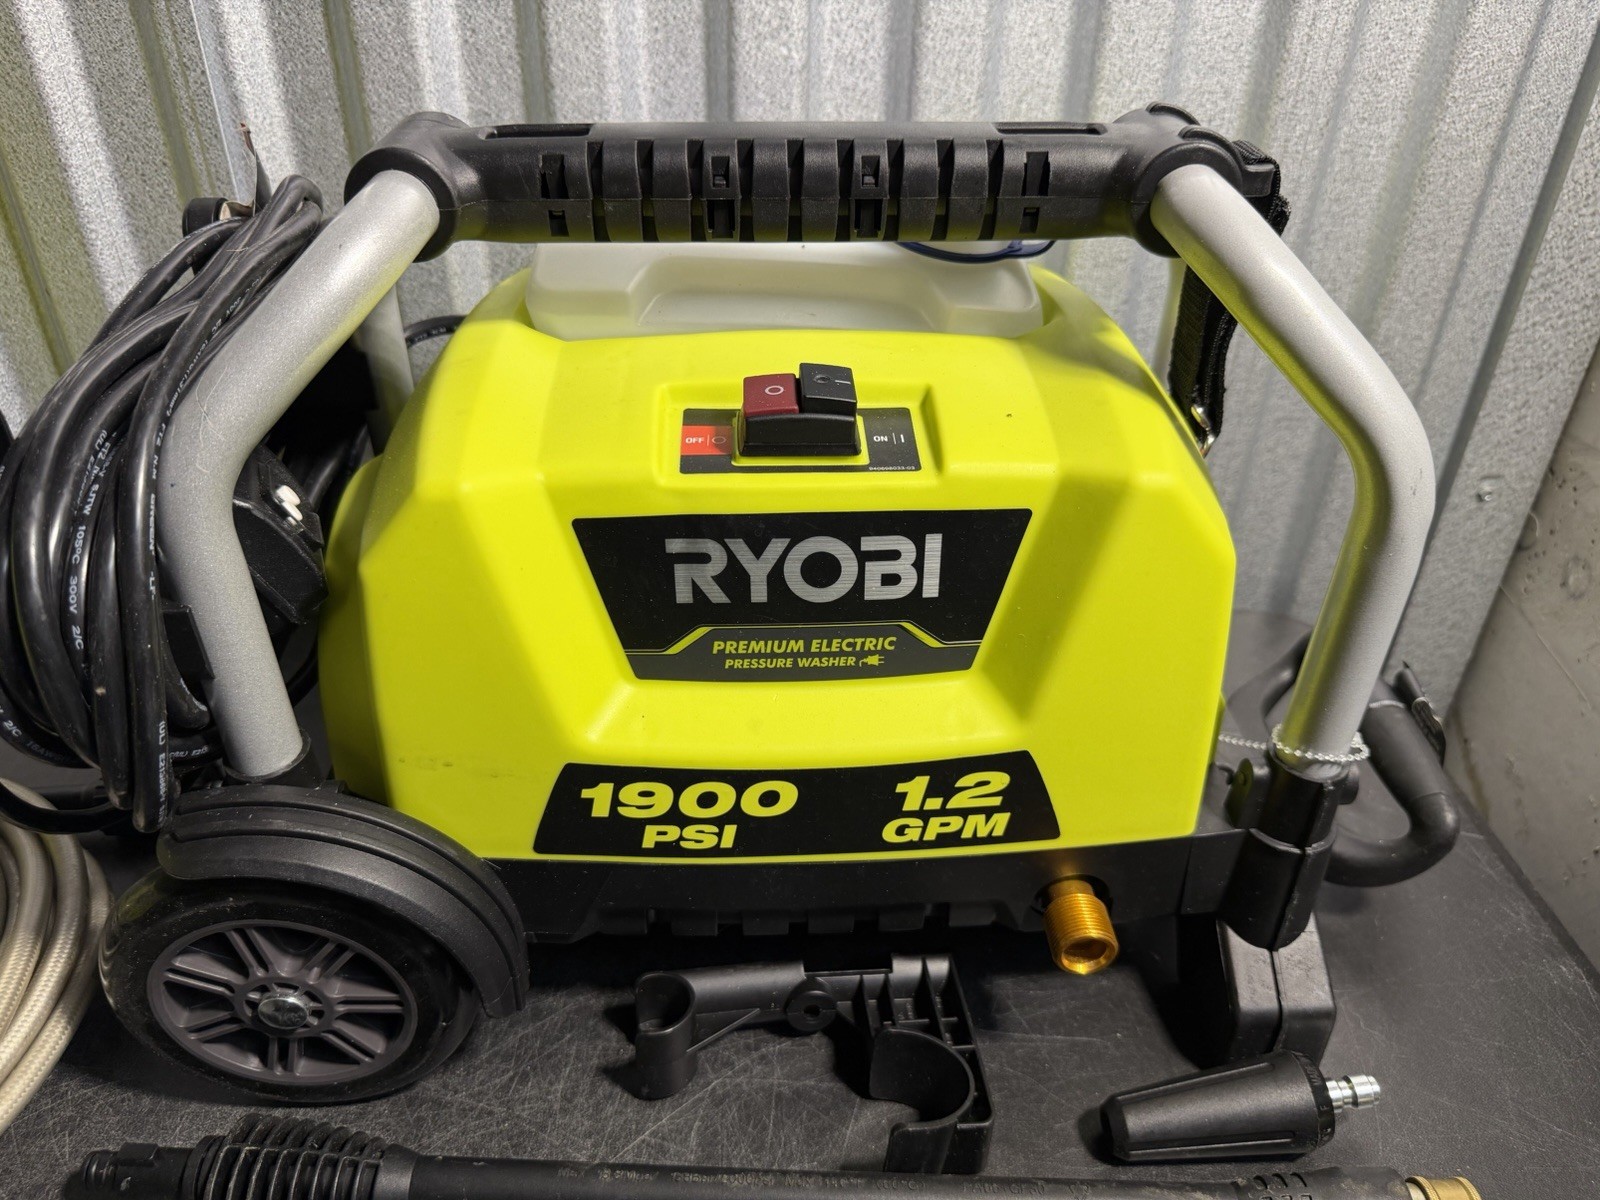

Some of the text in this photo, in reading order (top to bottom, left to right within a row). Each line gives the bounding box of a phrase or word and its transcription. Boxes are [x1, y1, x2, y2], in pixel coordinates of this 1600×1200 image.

[685, 436, 705, 444] OFF
[664, 533, 943, 604] RYOBI
[69, 575, 78, 614] 300V
[72, 625, 84, 650] 2/C
[712, 636, 897, 654] PREMIUM ELECTRIC
[724, 656, 856, 669] PRESSURE WASHER
[3, 720, 22, 737] 2/C
[580, 780, 799, 818] 1900
[895, 771, 1011, 811] 1.2
[641, 824, 738, 848] PSI
[881, 812, 1011, 843] GPM
